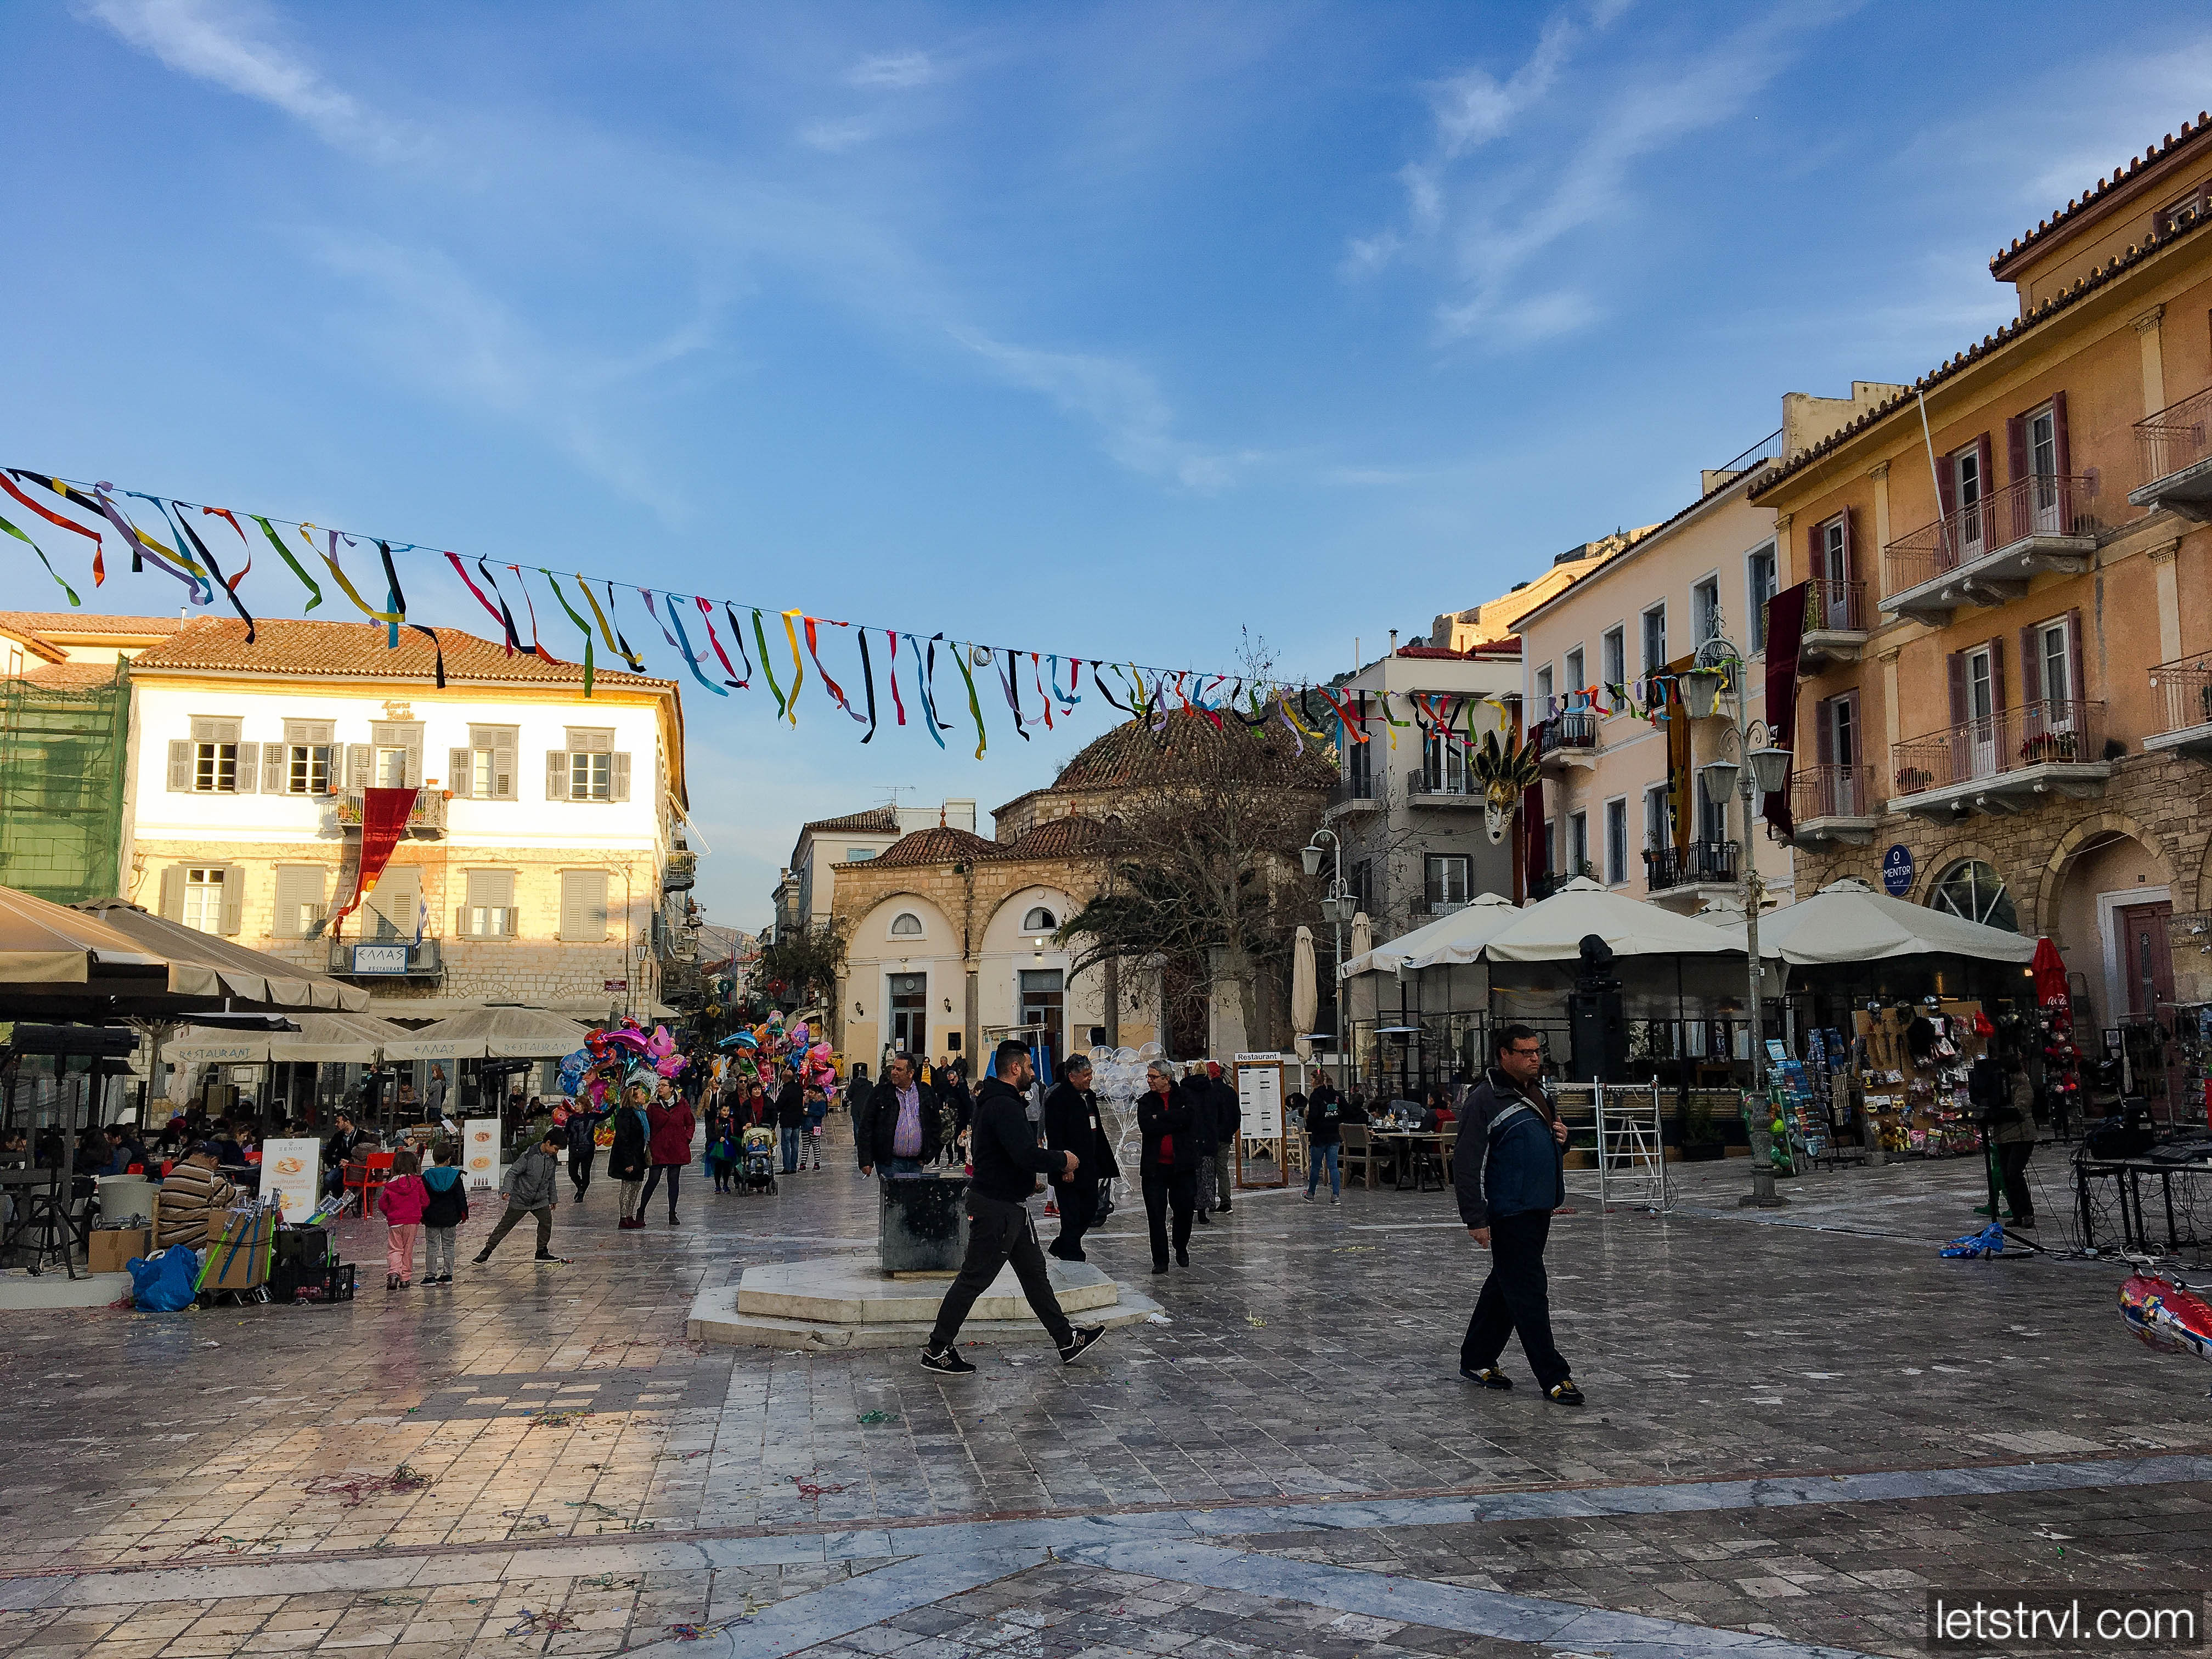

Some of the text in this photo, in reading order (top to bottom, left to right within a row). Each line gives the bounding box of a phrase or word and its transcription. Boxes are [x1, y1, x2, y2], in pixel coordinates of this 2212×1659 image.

[1883, 865, 1911, 878] MENTOR
[504, 1042, 572, 1052] RESTAURANT
[179, 1048, 251, 1059] RESTAURANT
